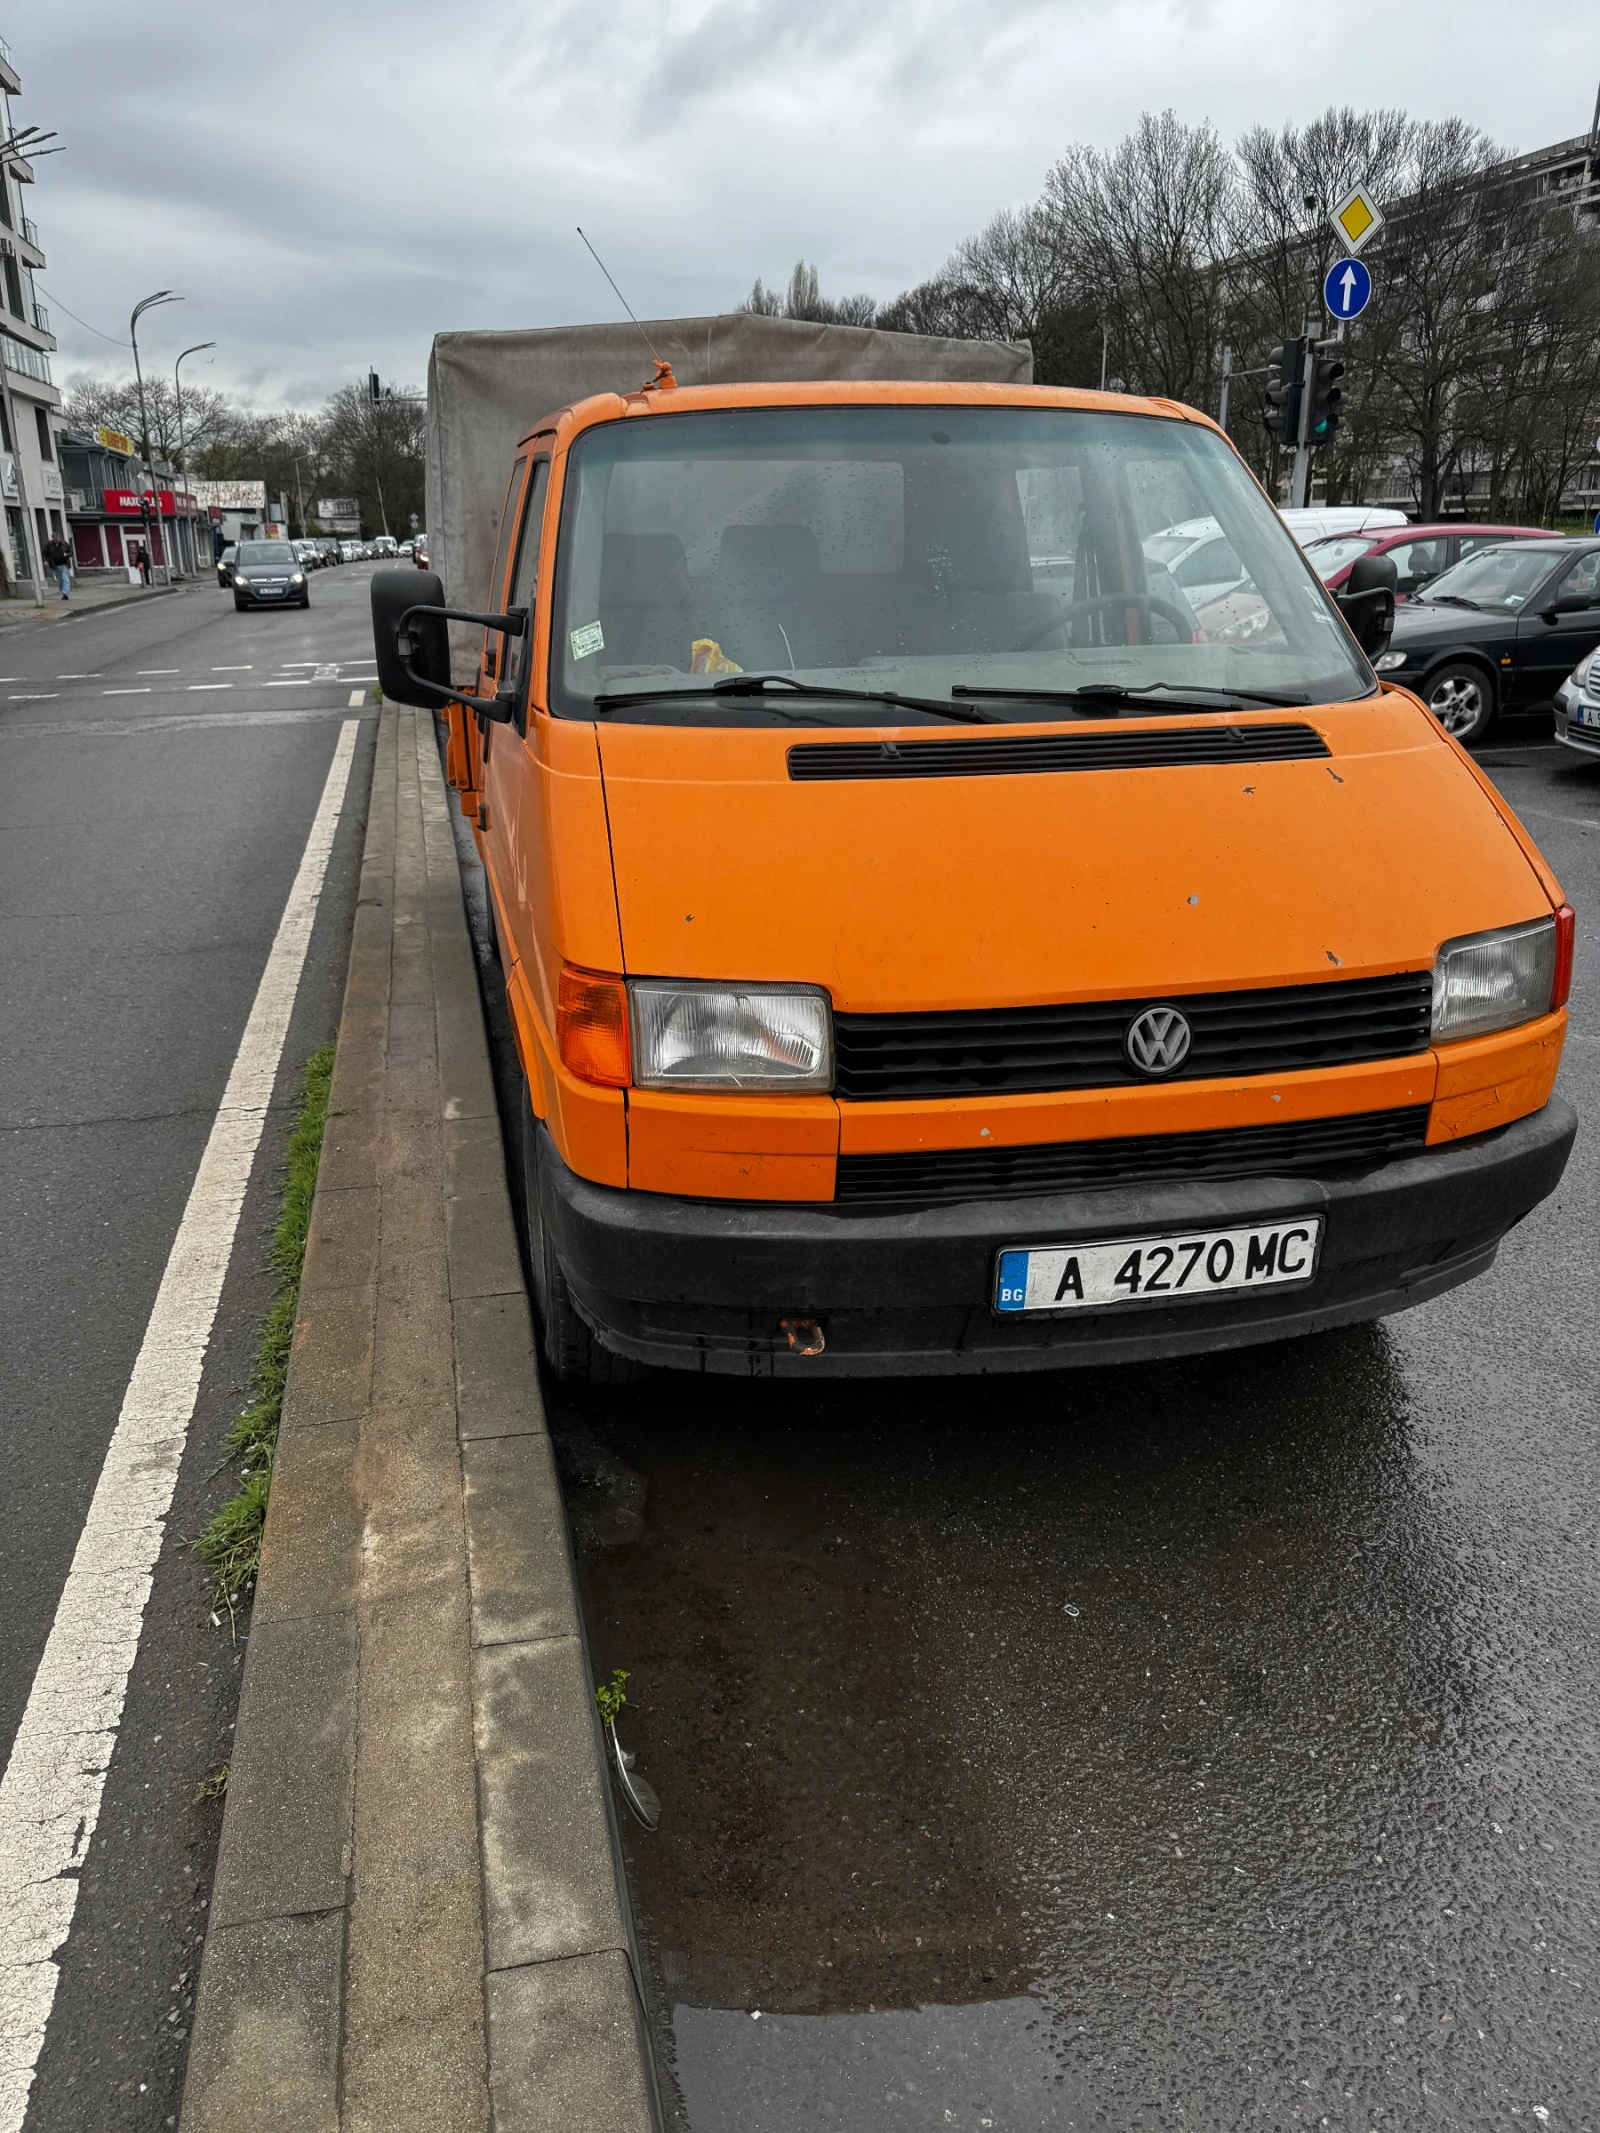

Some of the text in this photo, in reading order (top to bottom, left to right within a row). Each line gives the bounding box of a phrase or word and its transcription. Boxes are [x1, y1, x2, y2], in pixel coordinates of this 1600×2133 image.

[1587, 710, 1593, 725] A
[1054, 1228, 1309, 1301] A 4270 MC
[1001, 1288, 1024, 1302] BG
